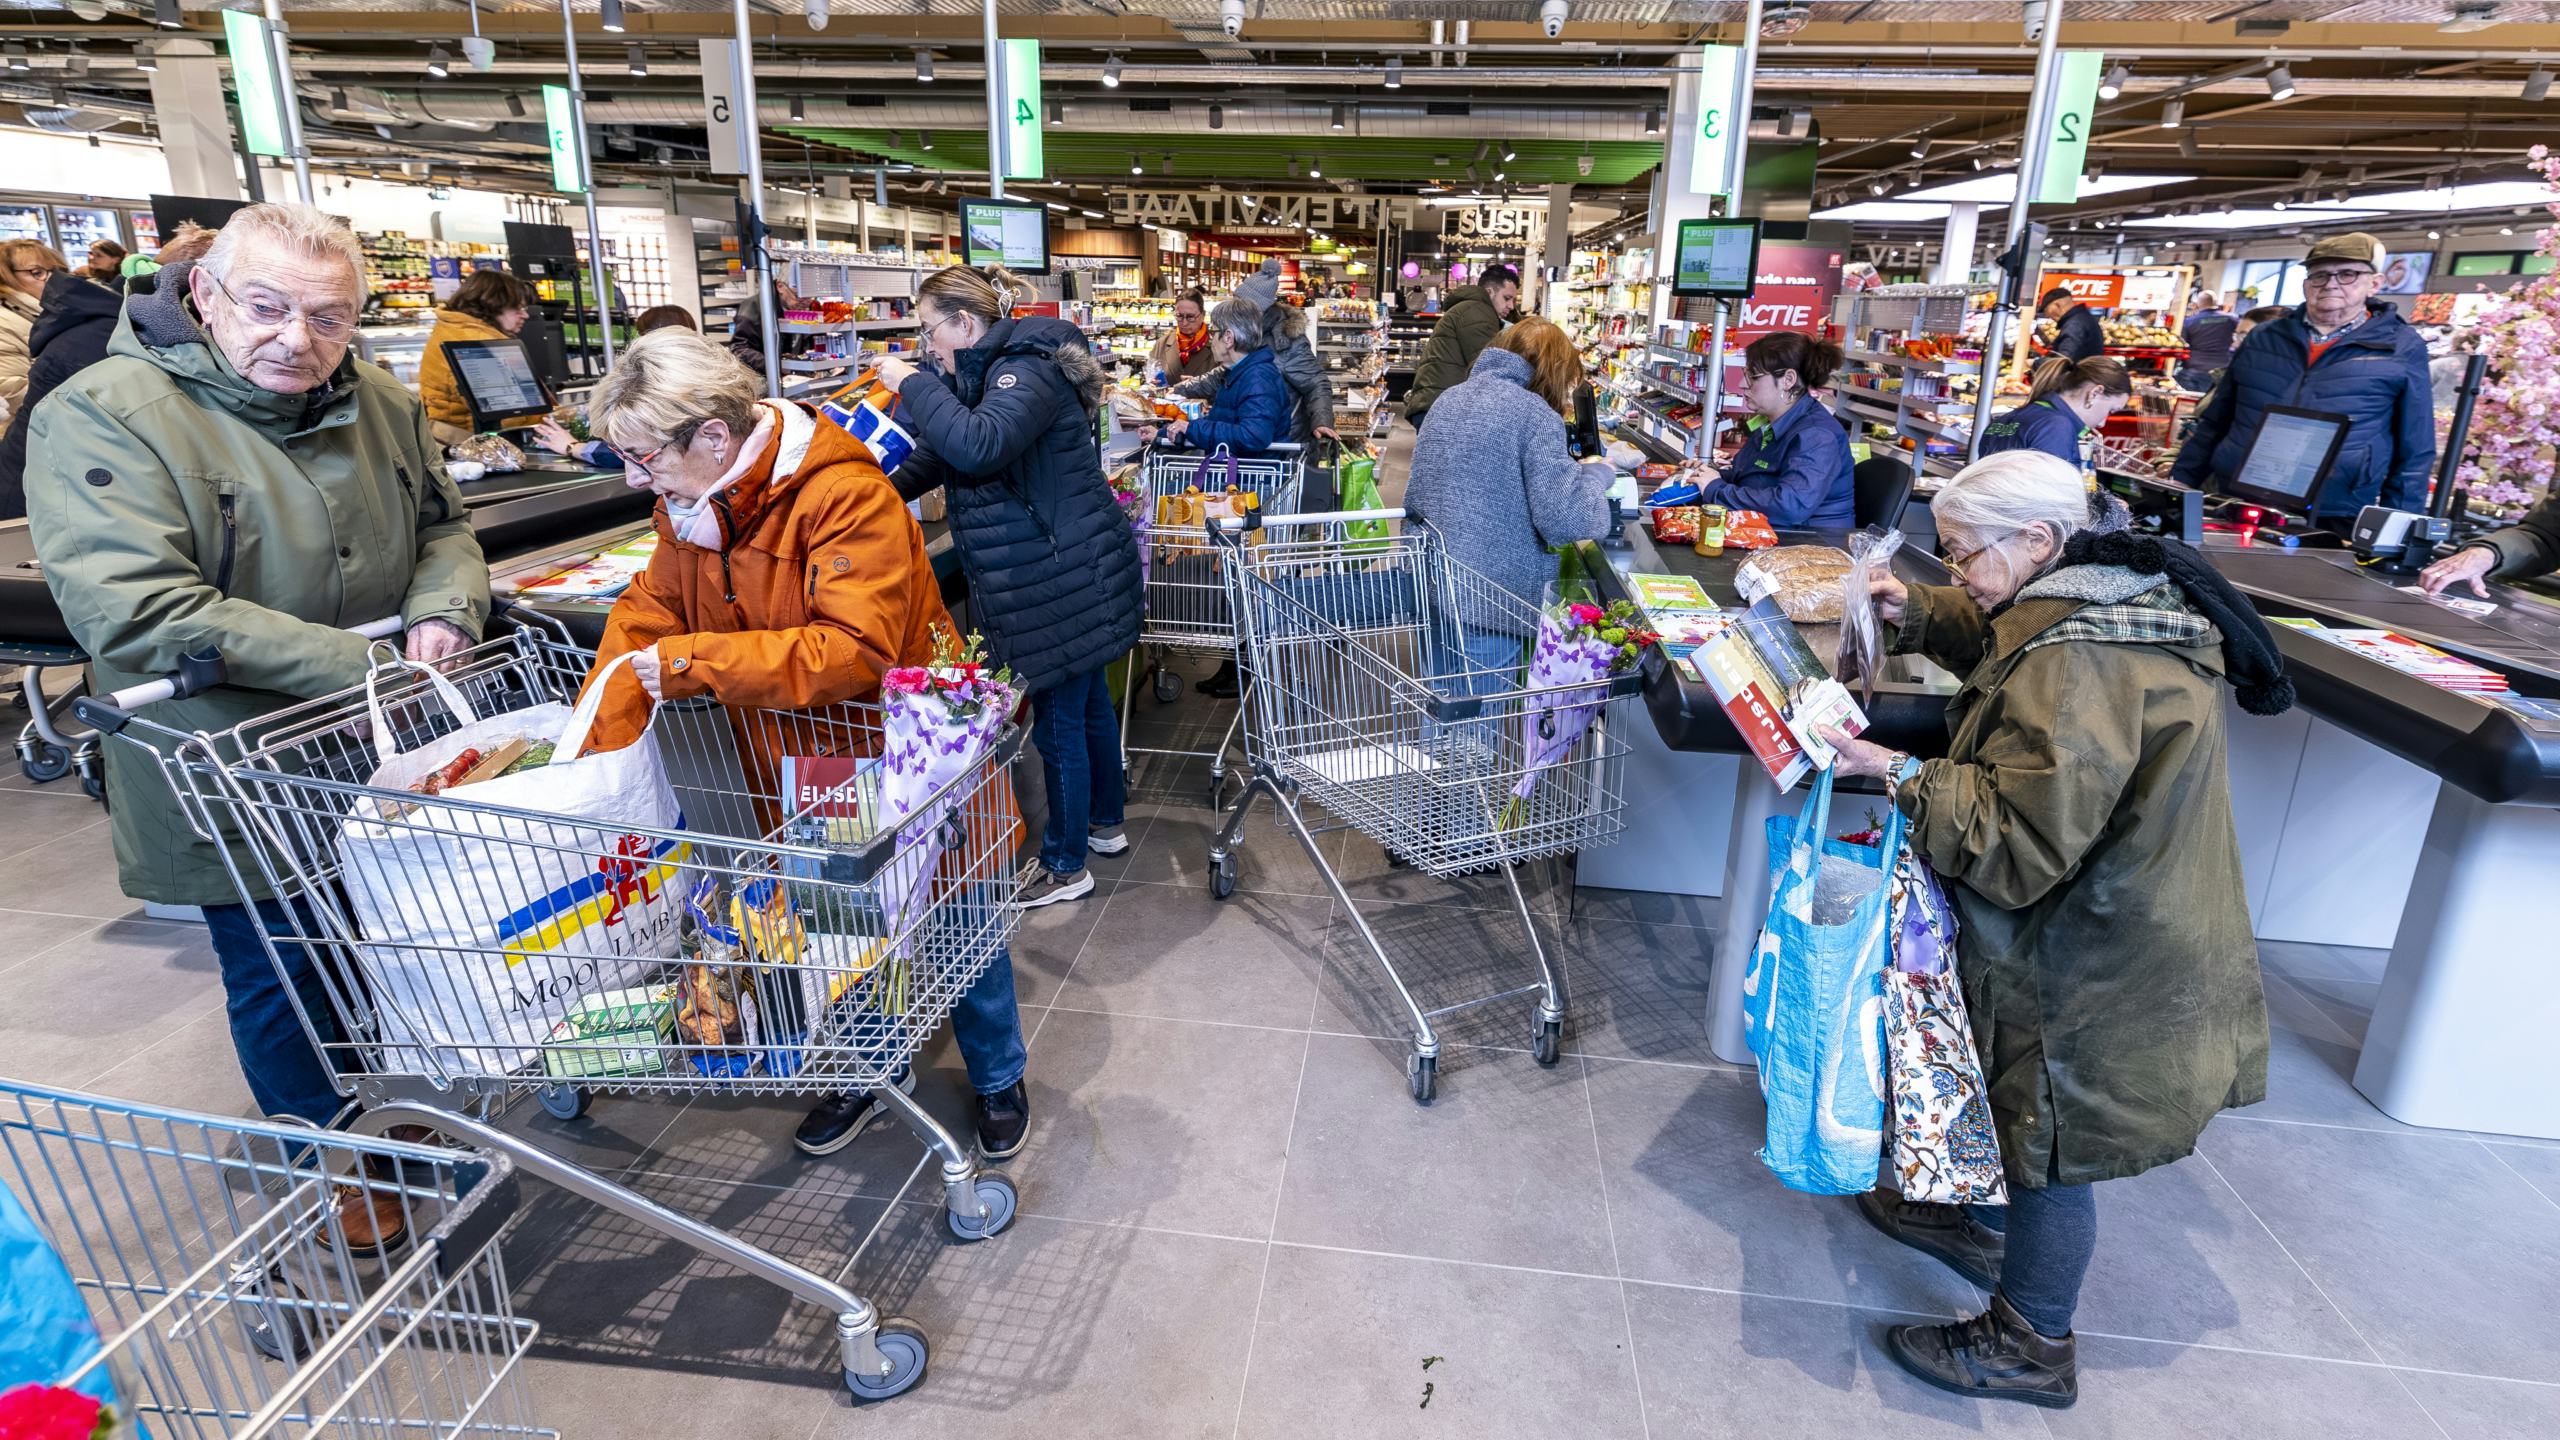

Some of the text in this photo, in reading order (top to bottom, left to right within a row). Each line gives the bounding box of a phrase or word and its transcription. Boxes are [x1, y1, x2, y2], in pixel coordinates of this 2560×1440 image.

[976, 208, 1001, 217] PLUS
[1866, 244, 1941, 268] VLEE
[1739, 303, 1812, 328] ACTIE
[1715, 651, 1793, 754] EIJSDEN
[800, 785, 879, 804] EIJSDE
[510, 959, 602, 1013] MOOI
[614, 896, 688, 958] LIMBU
